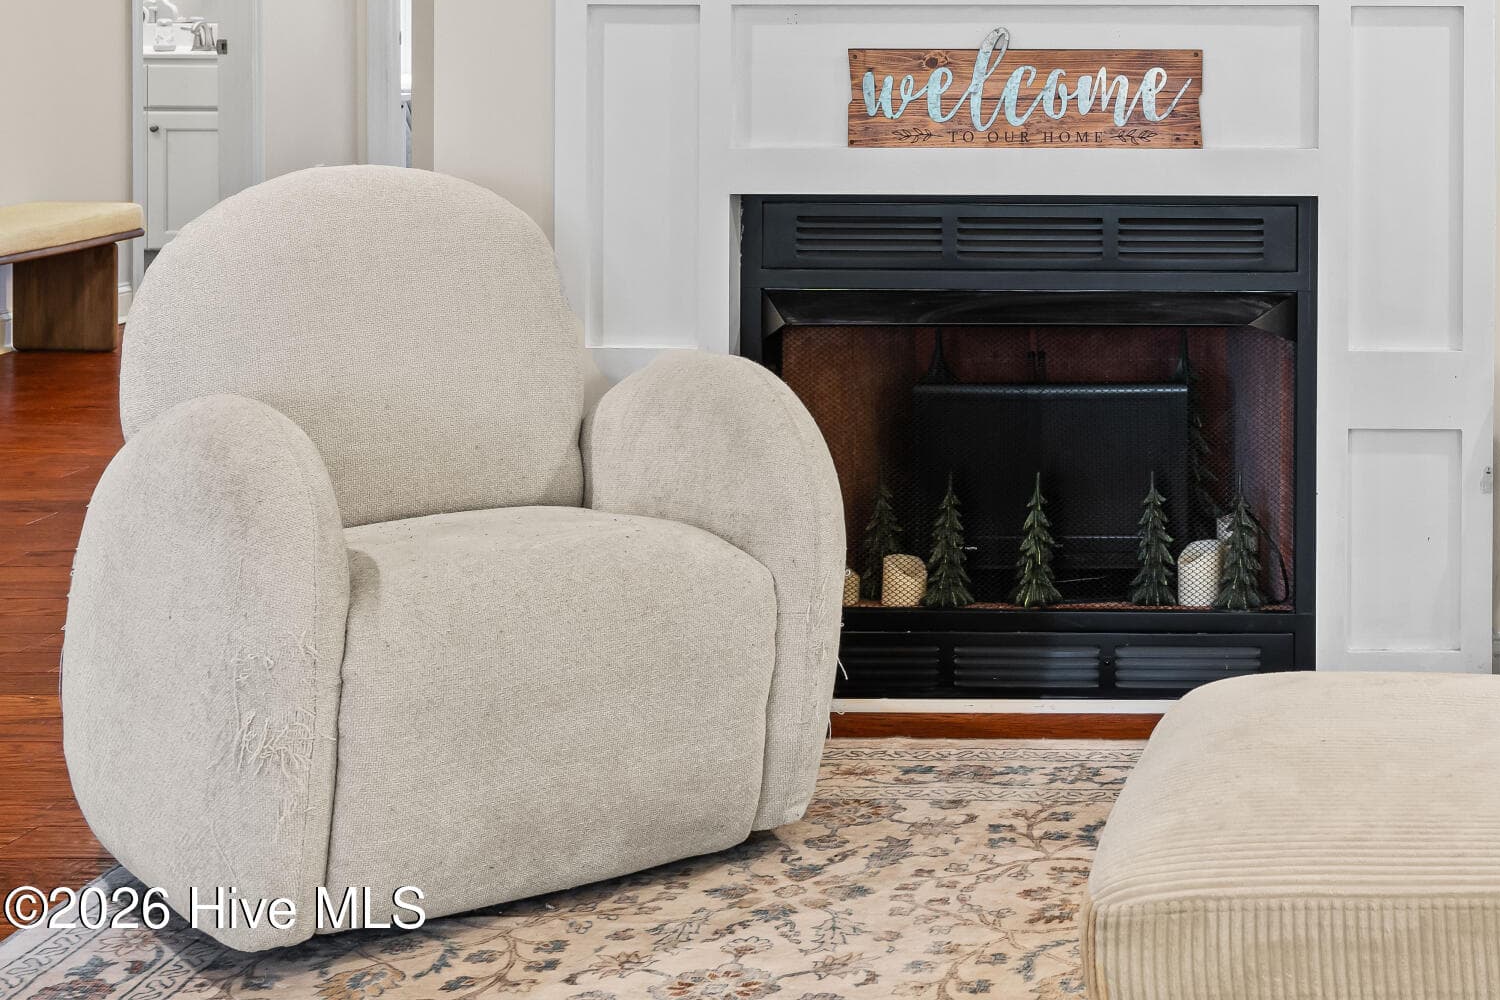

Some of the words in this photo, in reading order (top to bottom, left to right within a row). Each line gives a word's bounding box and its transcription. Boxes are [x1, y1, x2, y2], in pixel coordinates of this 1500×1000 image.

[862, 26, 1193, 132] welcome
[948, 130, 975, 143] TO
[987, 130, 1030, 143] OUR
[1043, 130, 1104, 143] HOME
